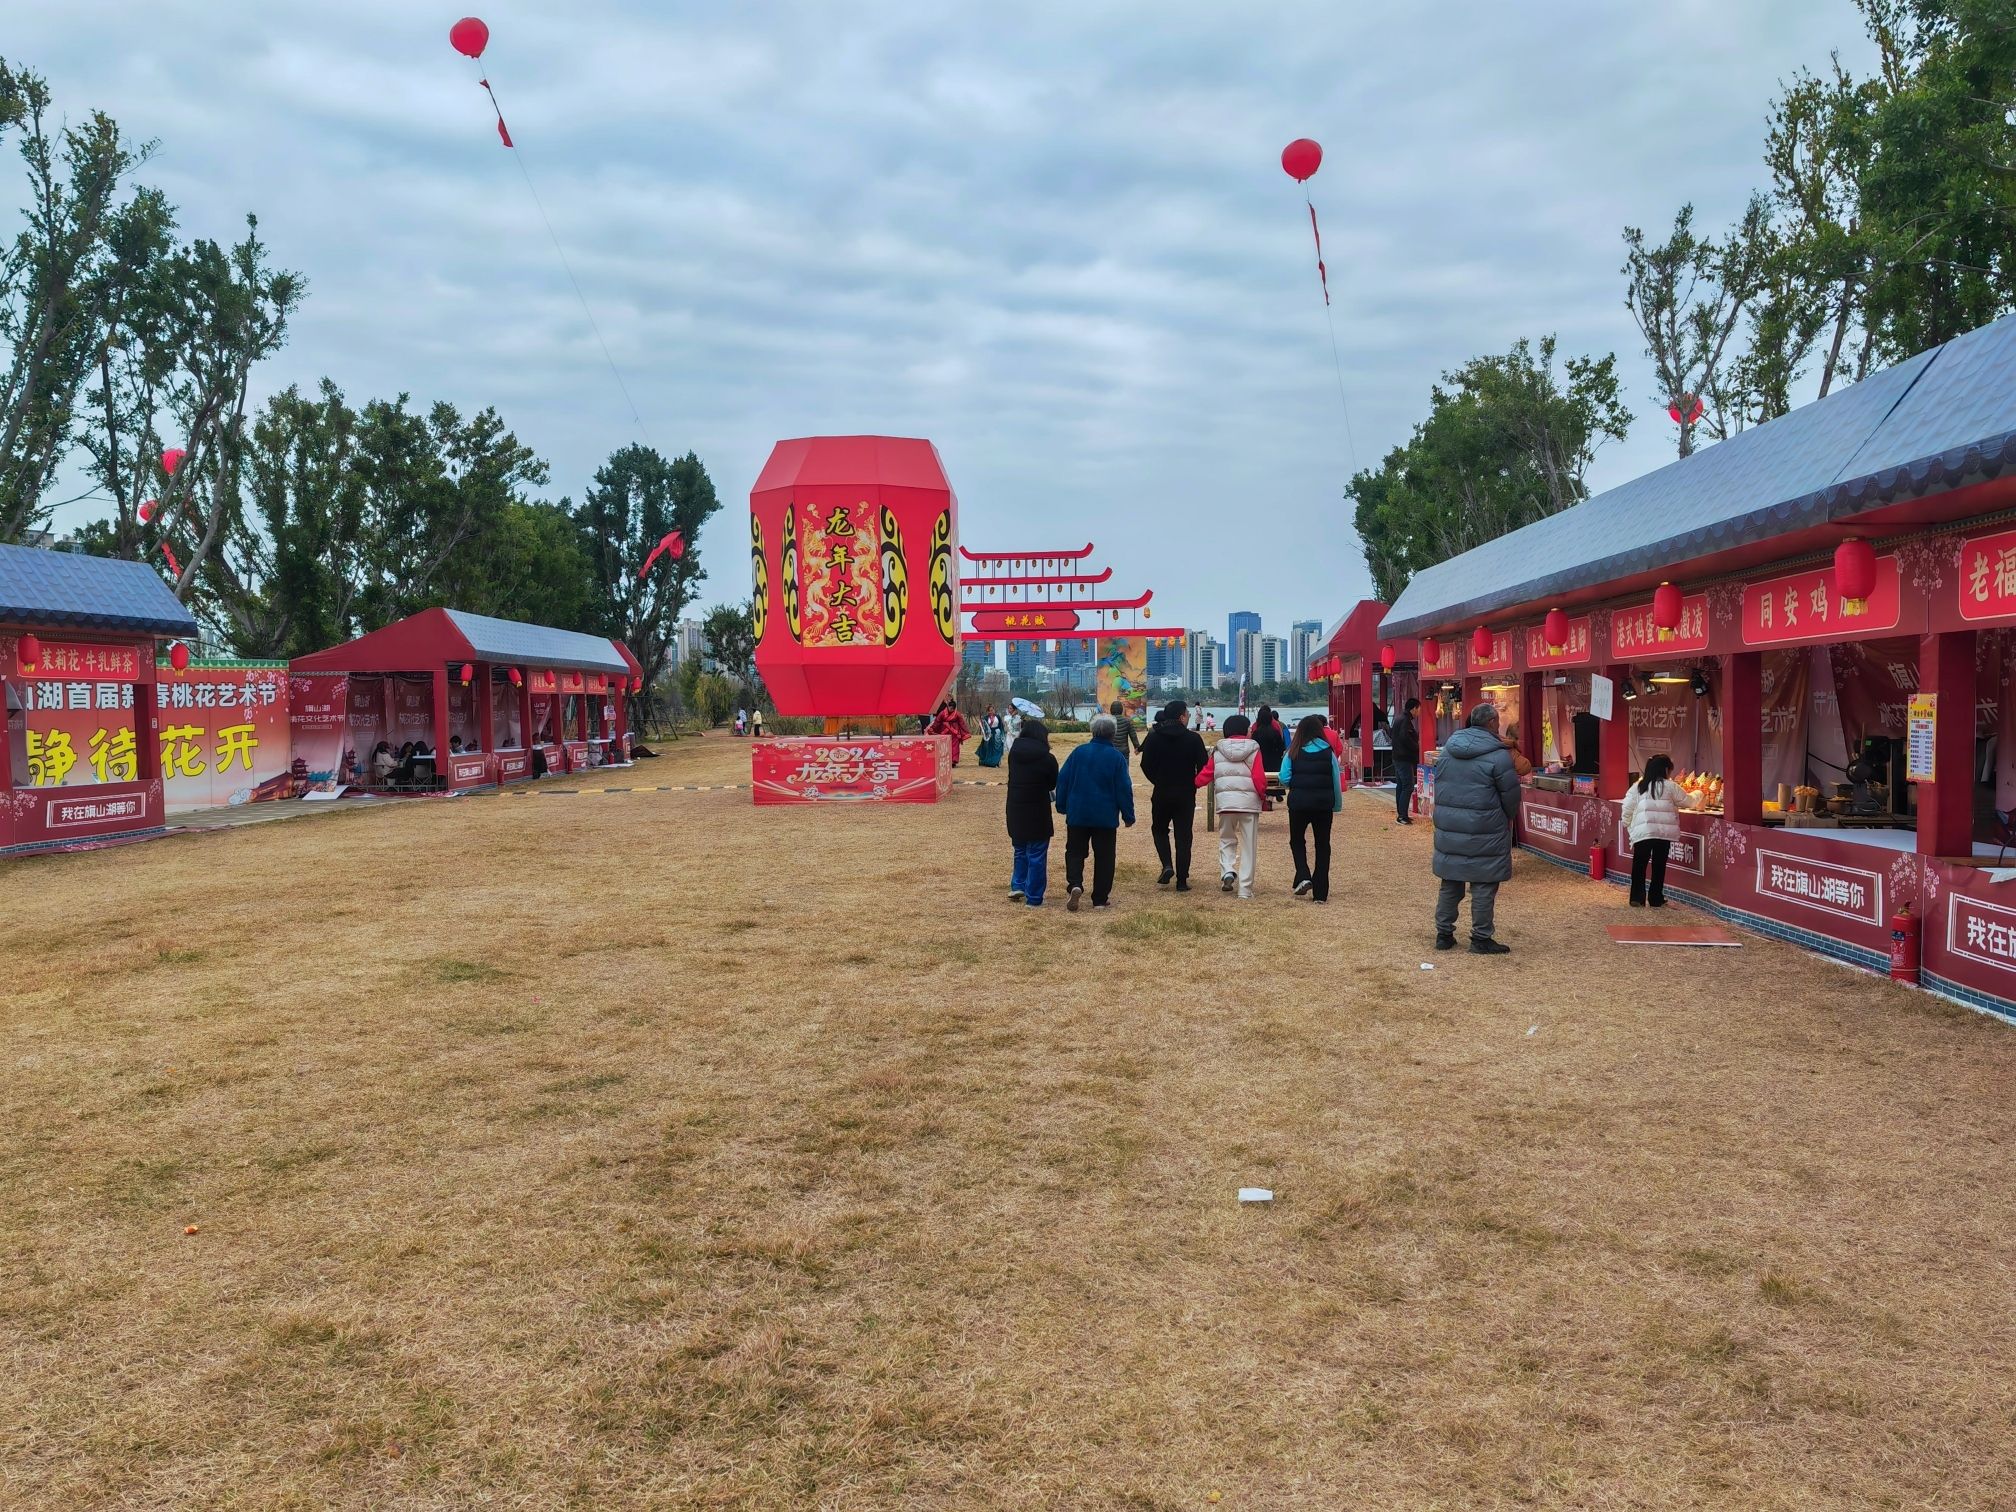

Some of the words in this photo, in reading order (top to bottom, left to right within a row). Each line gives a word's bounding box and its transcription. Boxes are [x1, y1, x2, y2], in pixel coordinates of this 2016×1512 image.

[826, 506, 858, 643] 龙年大吉
[1004, 614, 1047, 627] 桃花赋
[26, 724, 260, 787] 静待花开
[786, 760, 901, 785] 龙年大吉
[61, 800, 136, 821] 我在旗山湖等你
[1771, 864, 1866, 909] 我在旗山湖等你
